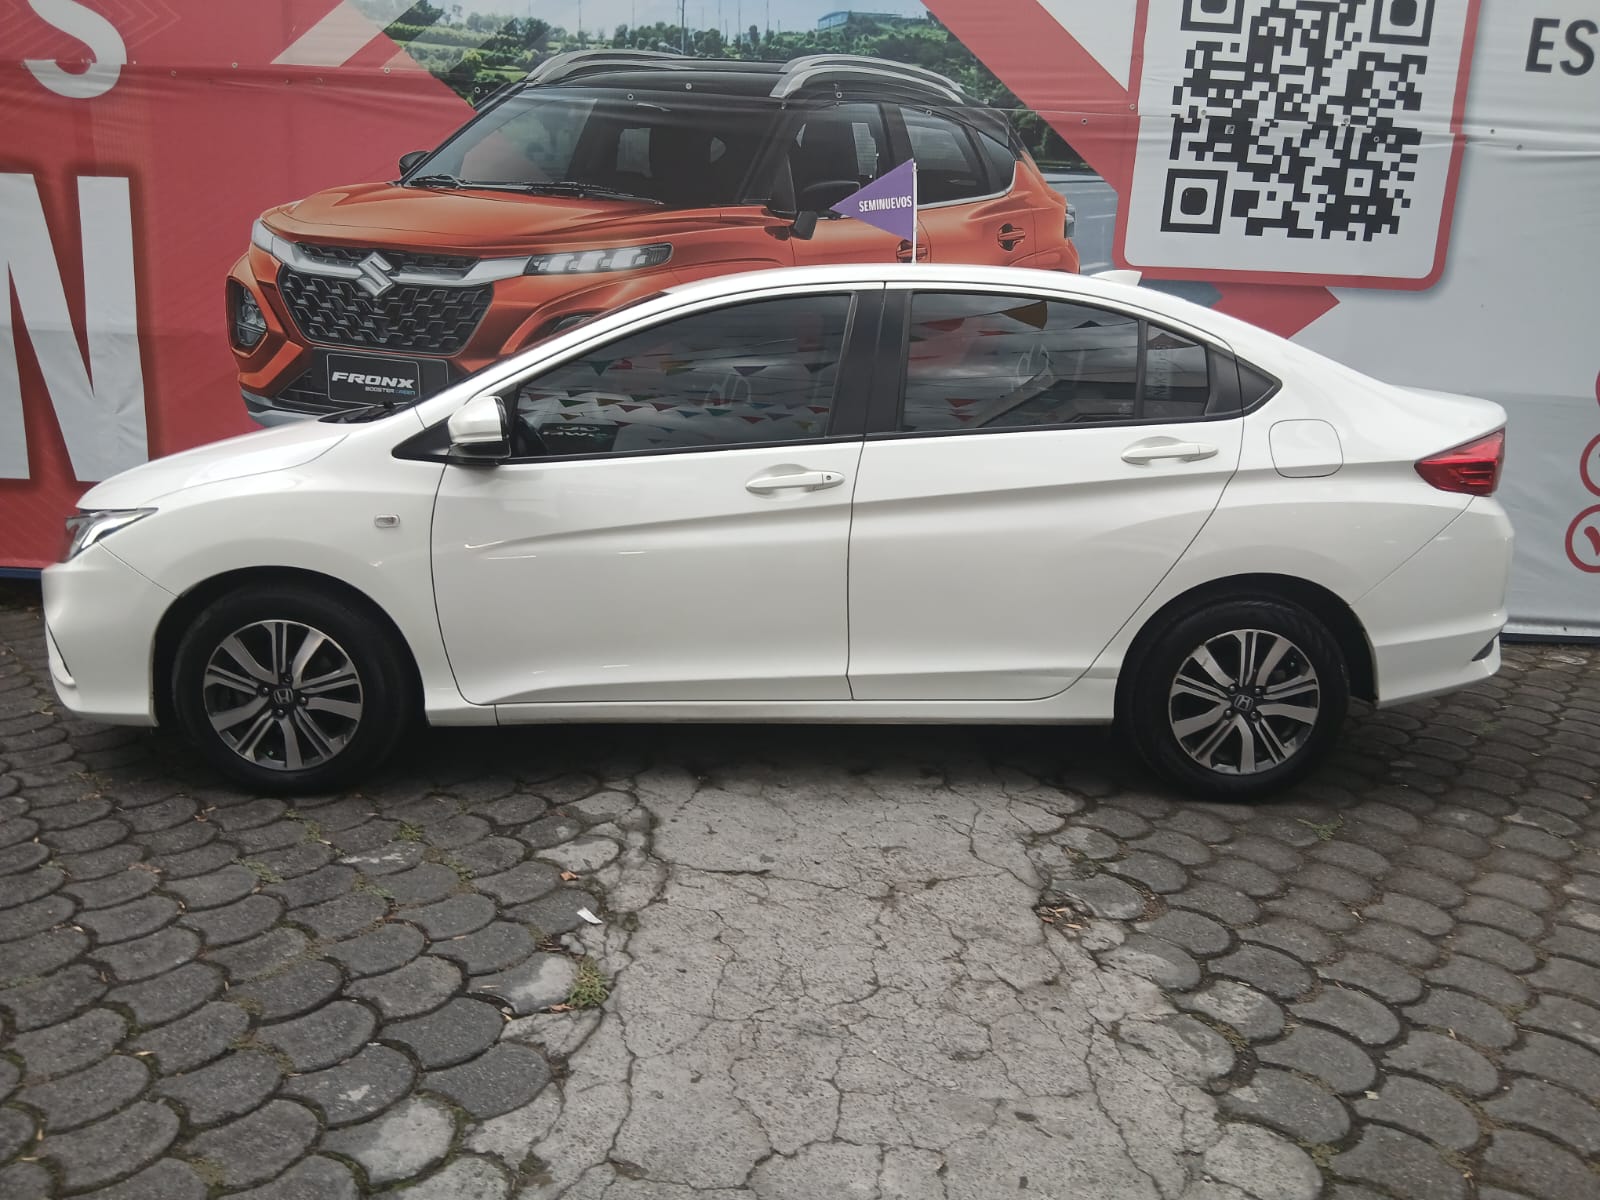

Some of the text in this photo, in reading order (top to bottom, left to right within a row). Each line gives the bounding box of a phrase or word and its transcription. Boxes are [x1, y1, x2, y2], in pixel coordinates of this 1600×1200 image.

[1525, 17, 1599, 76] ES
[858, 196, 912, 212] SEMINUEVOS
[332, 371, 415, 388] FRONX
